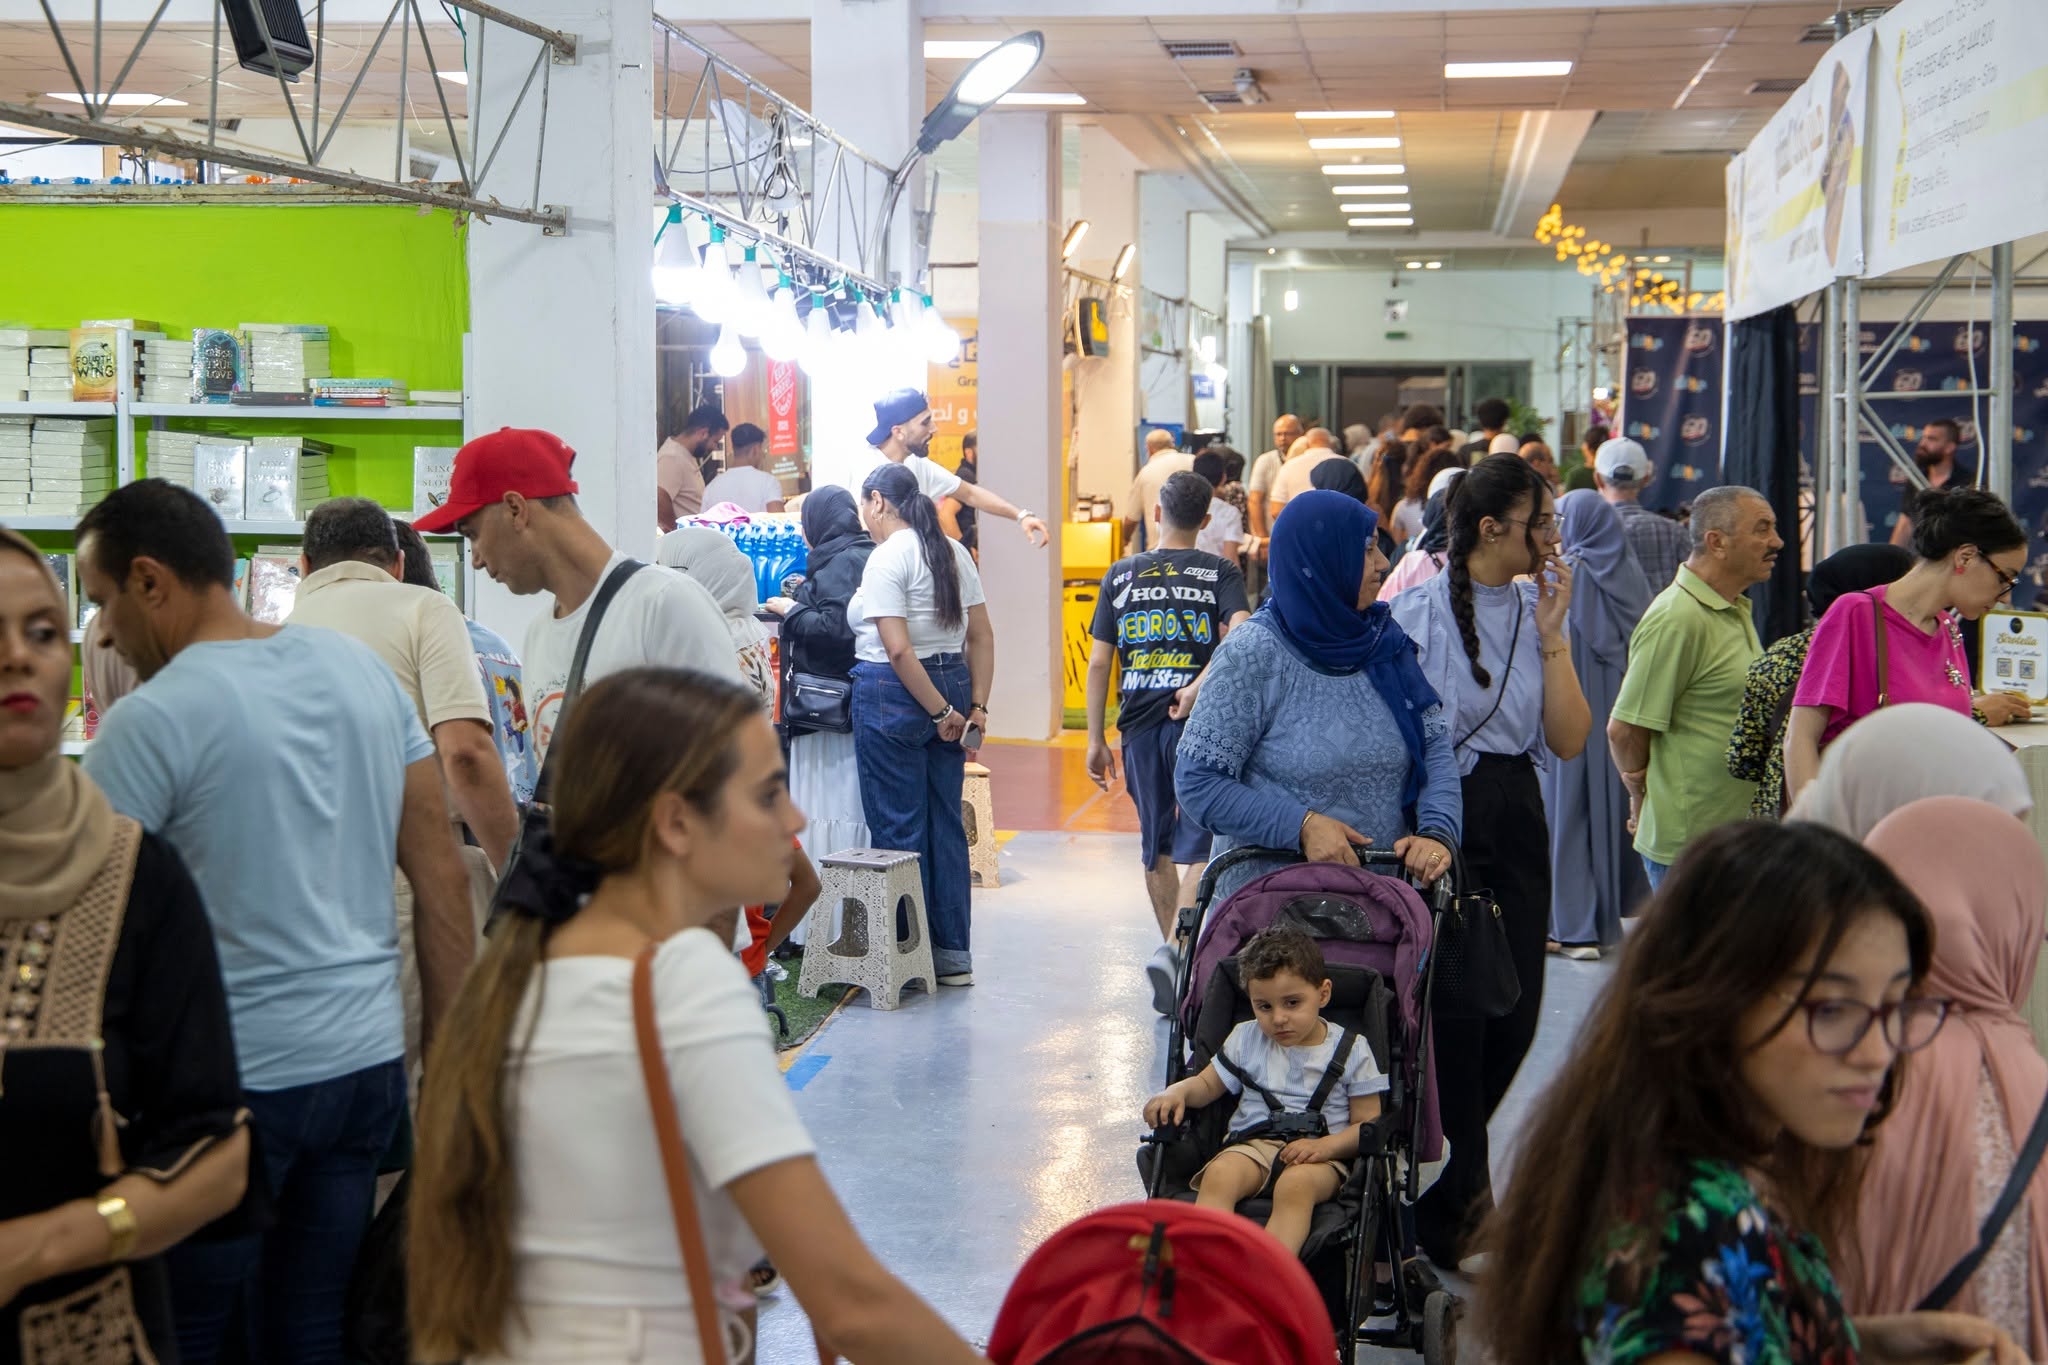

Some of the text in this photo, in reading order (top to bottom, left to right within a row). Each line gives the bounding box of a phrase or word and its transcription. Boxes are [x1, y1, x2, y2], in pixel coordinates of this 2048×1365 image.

[76, 354, 113, 366] FOURTH
[206, 359, 233, 369] TRUE
[76, 365, 114, 378] WING
[206, 370, 233, 379] LOVE
[958, 376, 978, 387] Gra
[423, 480, 449, 488] SLOT
[1131, 586, 1217, 605] HONDA
[1127, 648, 1193, 671] Teefnica
[1122, 669, 1193, 691] MviStar
